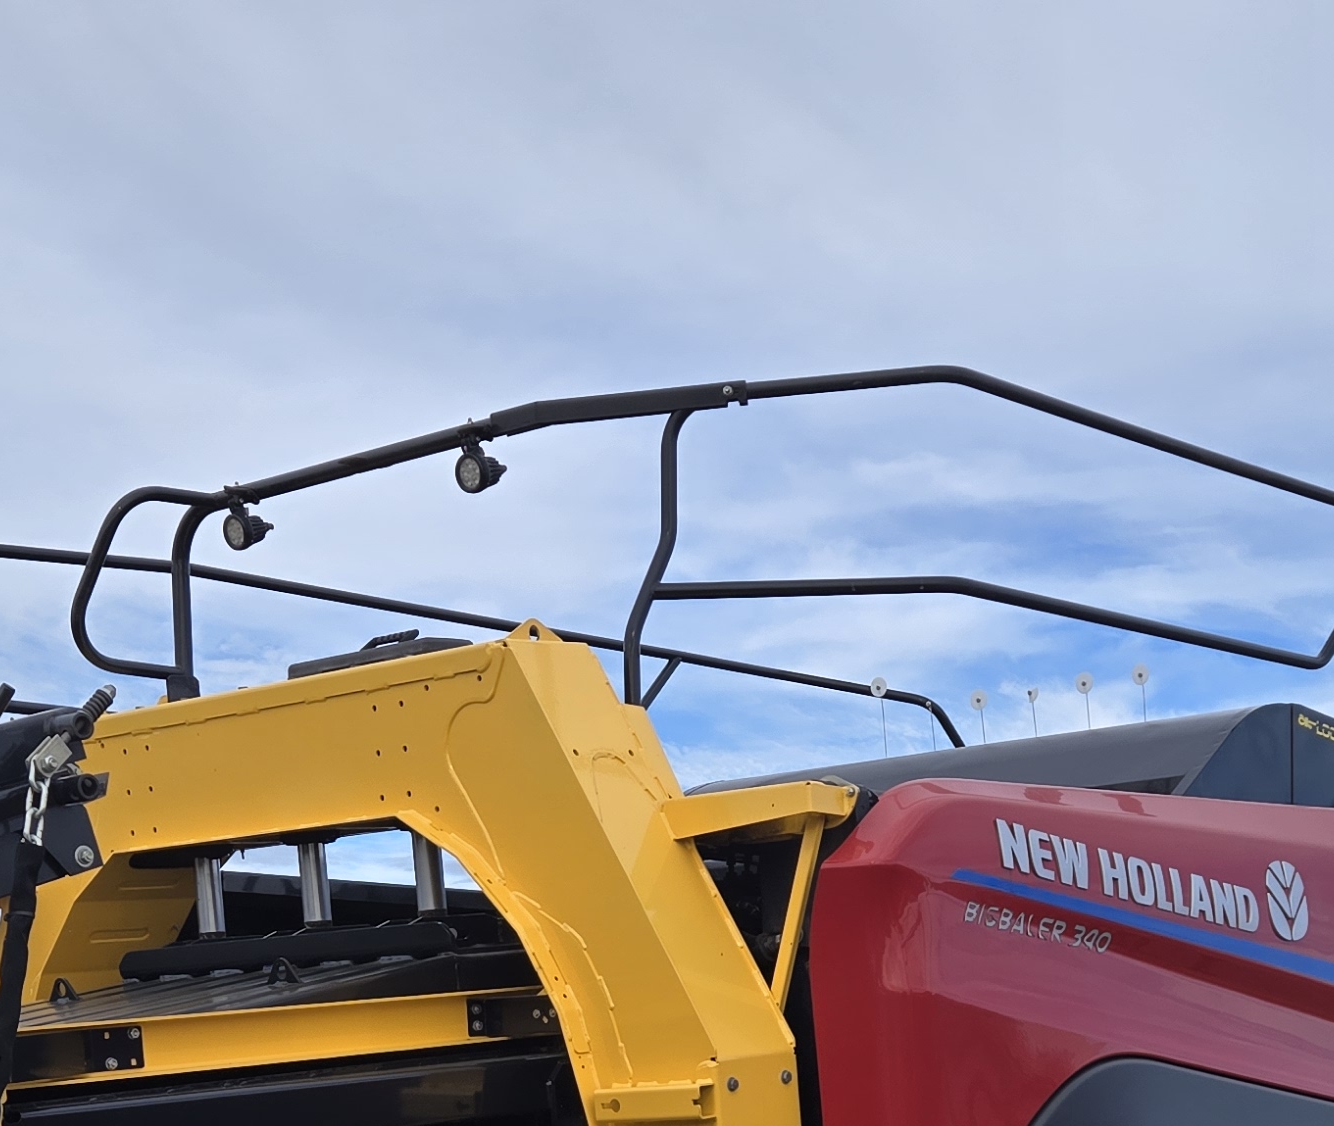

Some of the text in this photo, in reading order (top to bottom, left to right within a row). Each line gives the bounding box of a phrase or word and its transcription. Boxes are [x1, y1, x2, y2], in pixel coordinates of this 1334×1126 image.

[996, 818, 1260, 933] NEW HOLLAND
[964, 901, 1112, 954] BIGBALER 340
